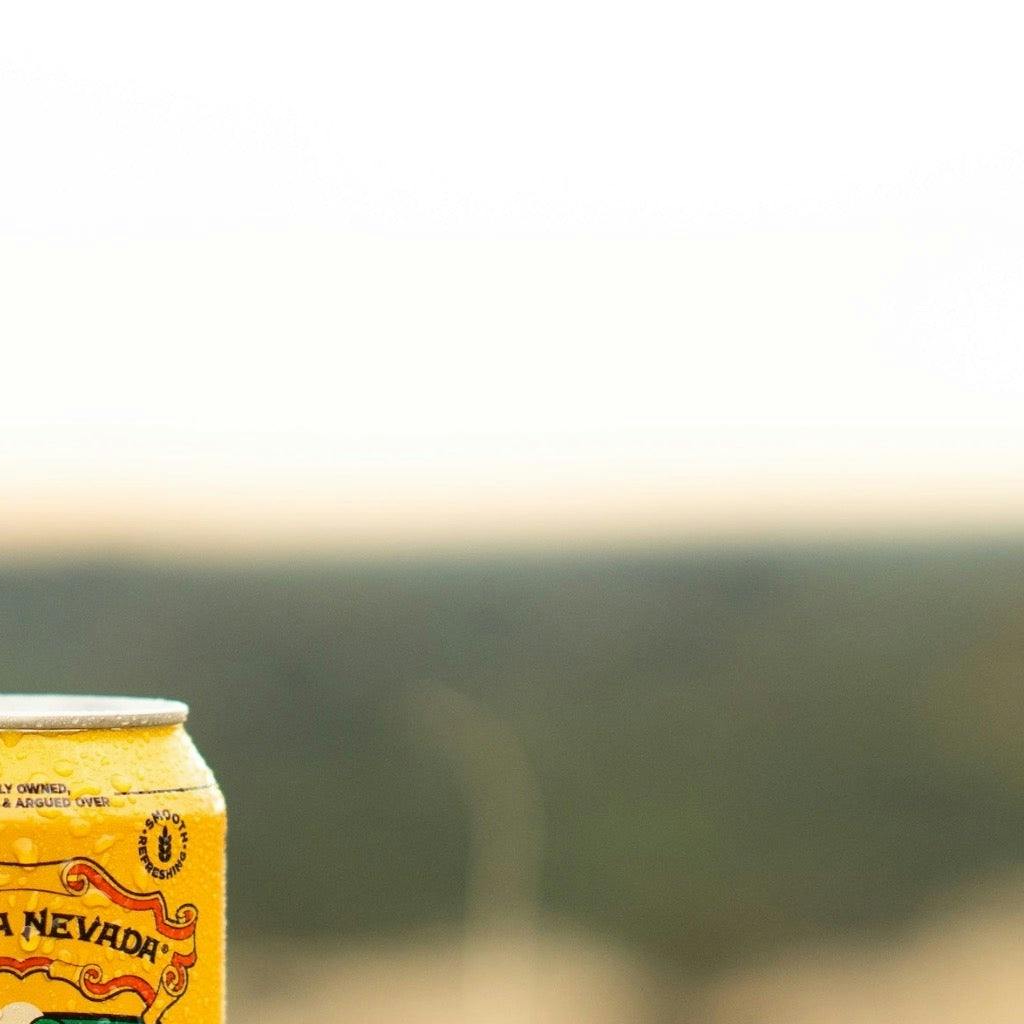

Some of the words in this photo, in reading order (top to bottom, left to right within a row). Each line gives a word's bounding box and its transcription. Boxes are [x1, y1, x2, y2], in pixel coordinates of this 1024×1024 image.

[17, 783, 71, 796] OWNED,
[2, 797, 11, 808] &
[15, 797, 71, 809] ARGUED
[76, 796, 111, 808] OVER
[145, 809, 188, 843] SMOOTH
[138, 835, 187, 880] REFRESHING
